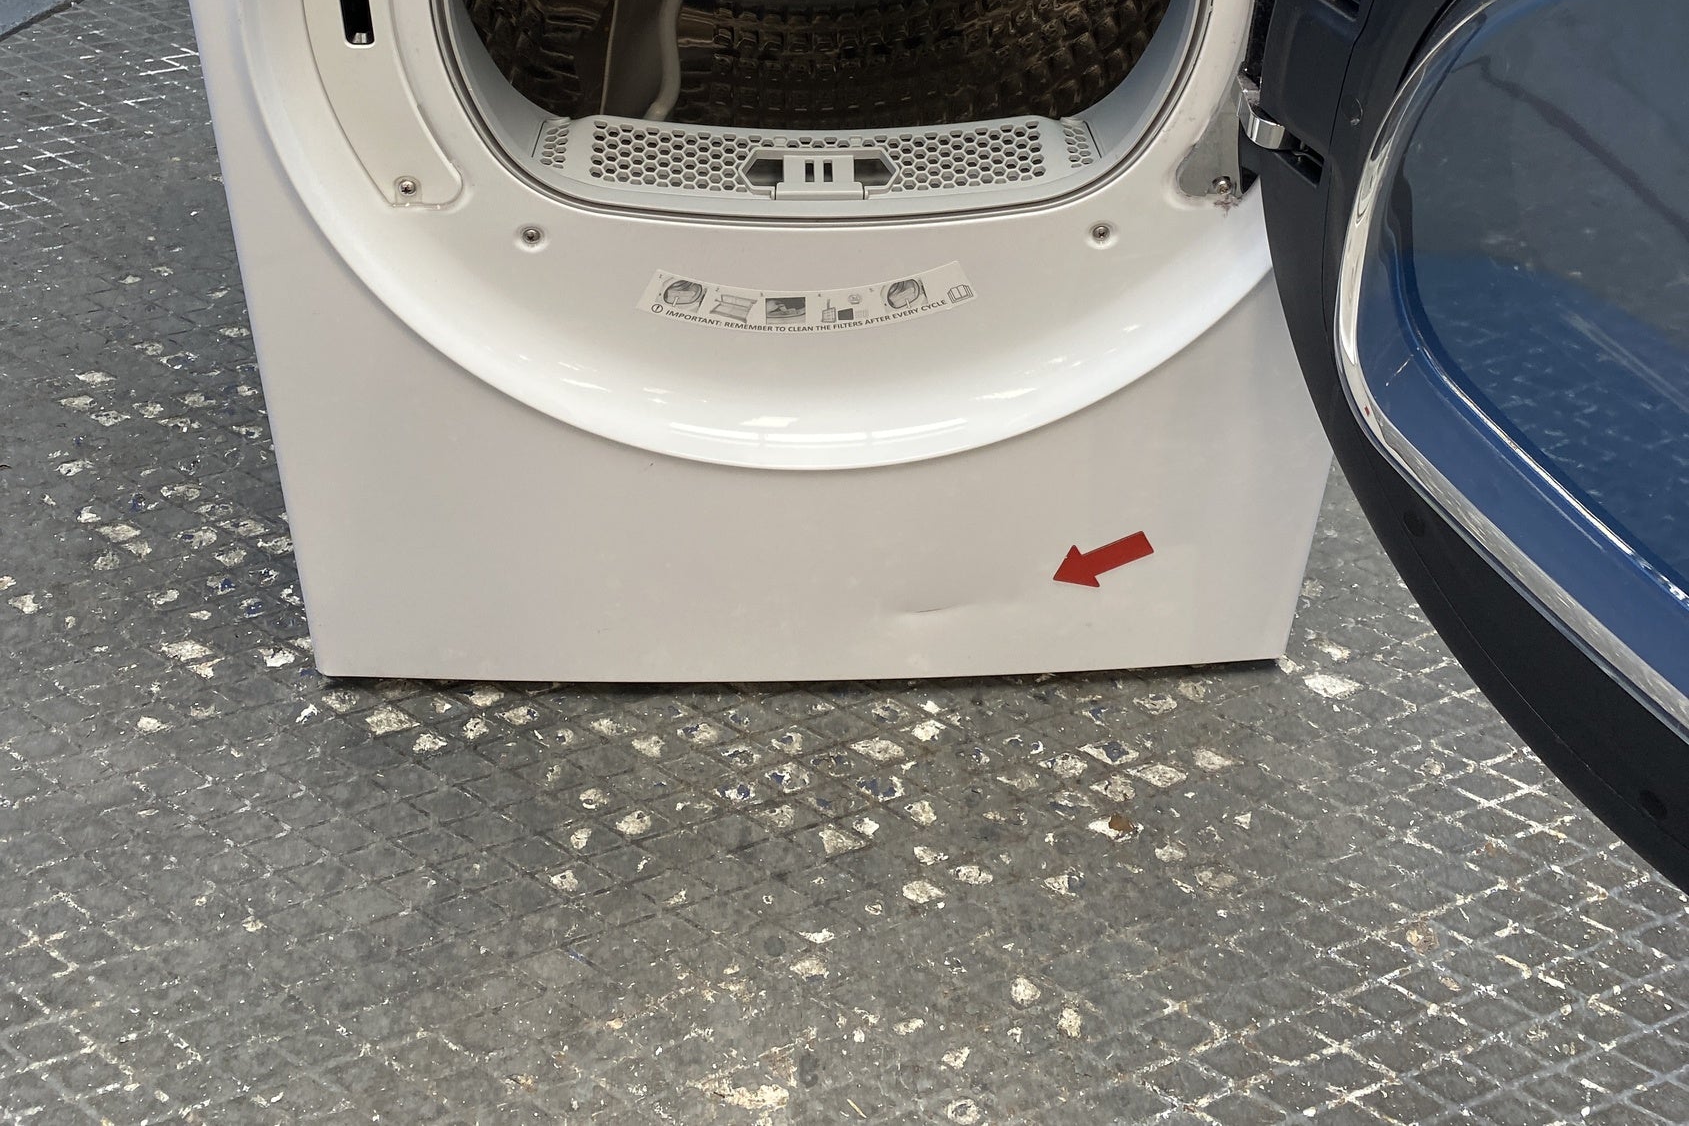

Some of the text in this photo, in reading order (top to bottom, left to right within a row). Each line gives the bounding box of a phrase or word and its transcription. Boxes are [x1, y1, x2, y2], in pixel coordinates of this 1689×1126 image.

[665, 309, 722, 326] IMPORTANT:
[724, 321, 773, 332] REMEMBER
[833, 320, 863, 330] FILTERS
[864, 315, 891, 325] AFTER
[892, 308, 919, 319] EVERY
[921, 299, 948, 312] CYCLE
